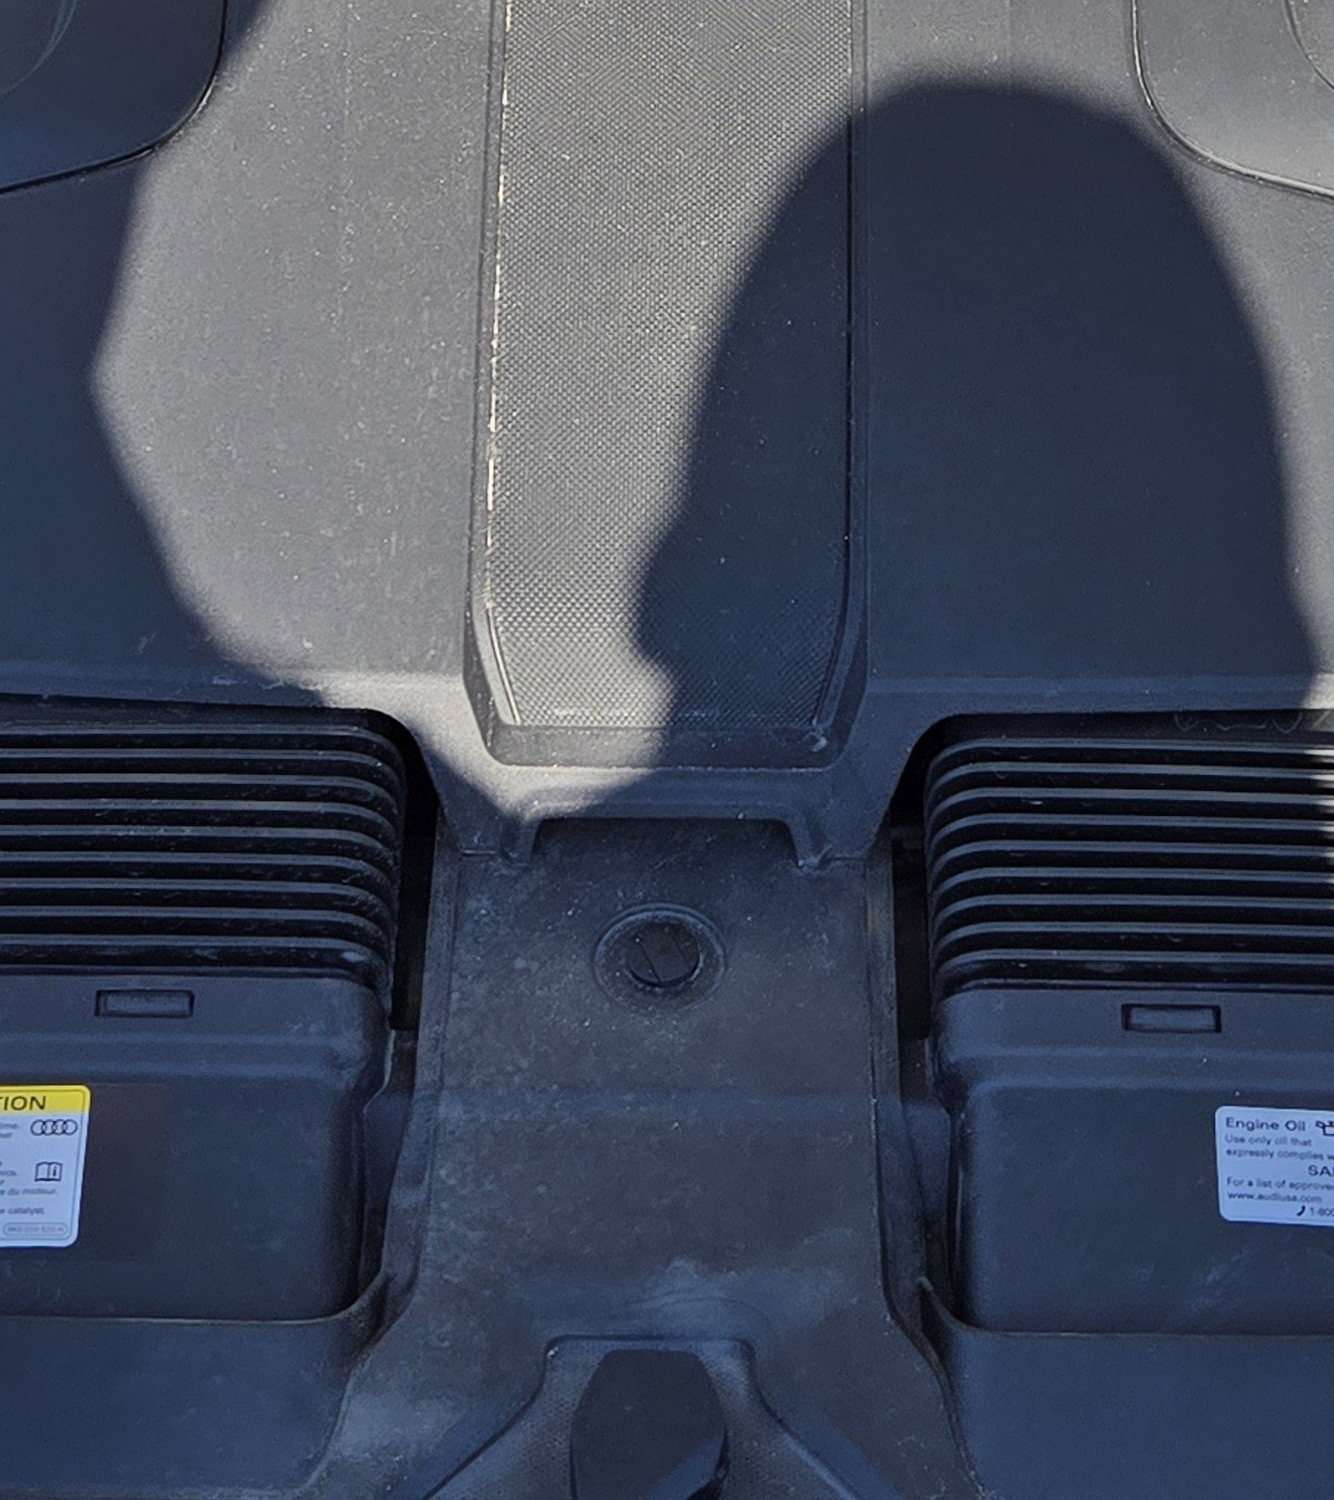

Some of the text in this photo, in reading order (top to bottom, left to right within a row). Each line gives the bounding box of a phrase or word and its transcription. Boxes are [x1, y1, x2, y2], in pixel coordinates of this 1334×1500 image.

[1225, 1116, 1307, 1132] Engine Oil
[1225, 1133, 1313, 1147] Use only oil that
[1226, 1148, 1275, 1160] expressly
[1277, 1150, 1324, 1161] complies
[1226, 1176, 1245, 1187] For
[1247, 1179, 1254, 1188] a
[1256, 1178, 1273, 1189] list
[1274, 1179, 1287, 1189] of
